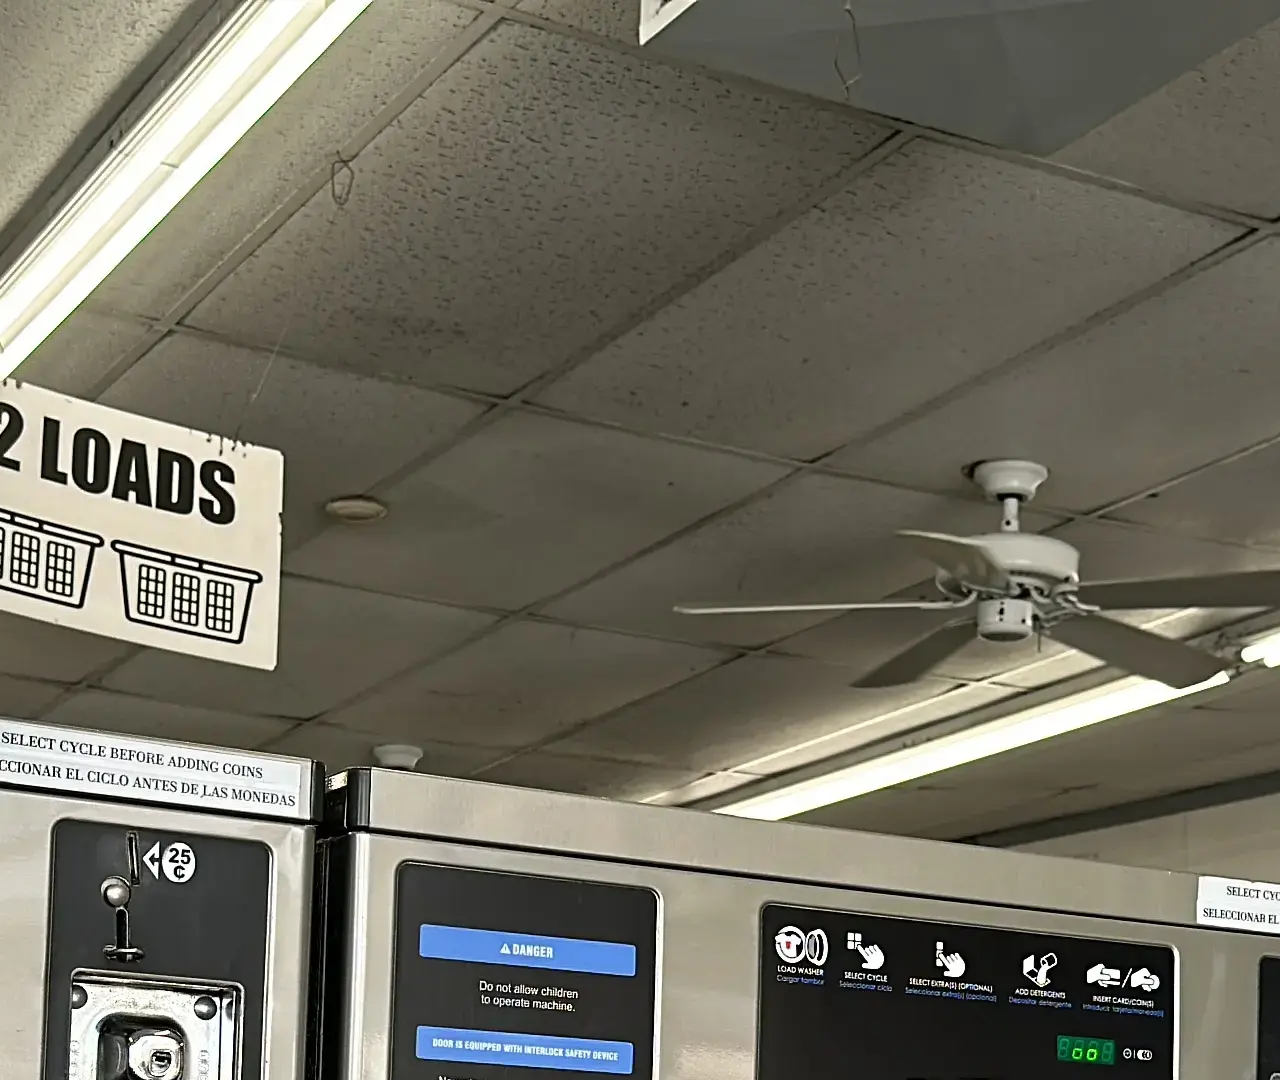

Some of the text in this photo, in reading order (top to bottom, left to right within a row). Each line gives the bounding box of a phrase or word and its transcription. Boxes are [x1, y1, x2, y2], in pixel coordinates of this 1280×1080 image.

[40, 416, 236, 525] LOADS
[2, 732, 262, 779] SELECT CYCLE BEFORE ADDING COINS
[66, 768, 83, 781] EL
[88, 771, 129, 786] CICLO
[133, 777, 177, 792] ANTES
[181, 782, 198, 795] DE
[201, 785, 228, 798] LAS
[232, 789, 295, 807] MONEDAS
[169, 848, 191, 864] 25
[1227, 886, 1261, 899] SELECT
[1203, 908, 1265, 923] SELECCIONAR
[1269, 915, 1279, 924] EL
[513, 944, 552, 958] DANGER
[480, 981, 578, 999] Do not allow children
[482, 995, 575, 1012] to operate machine.
